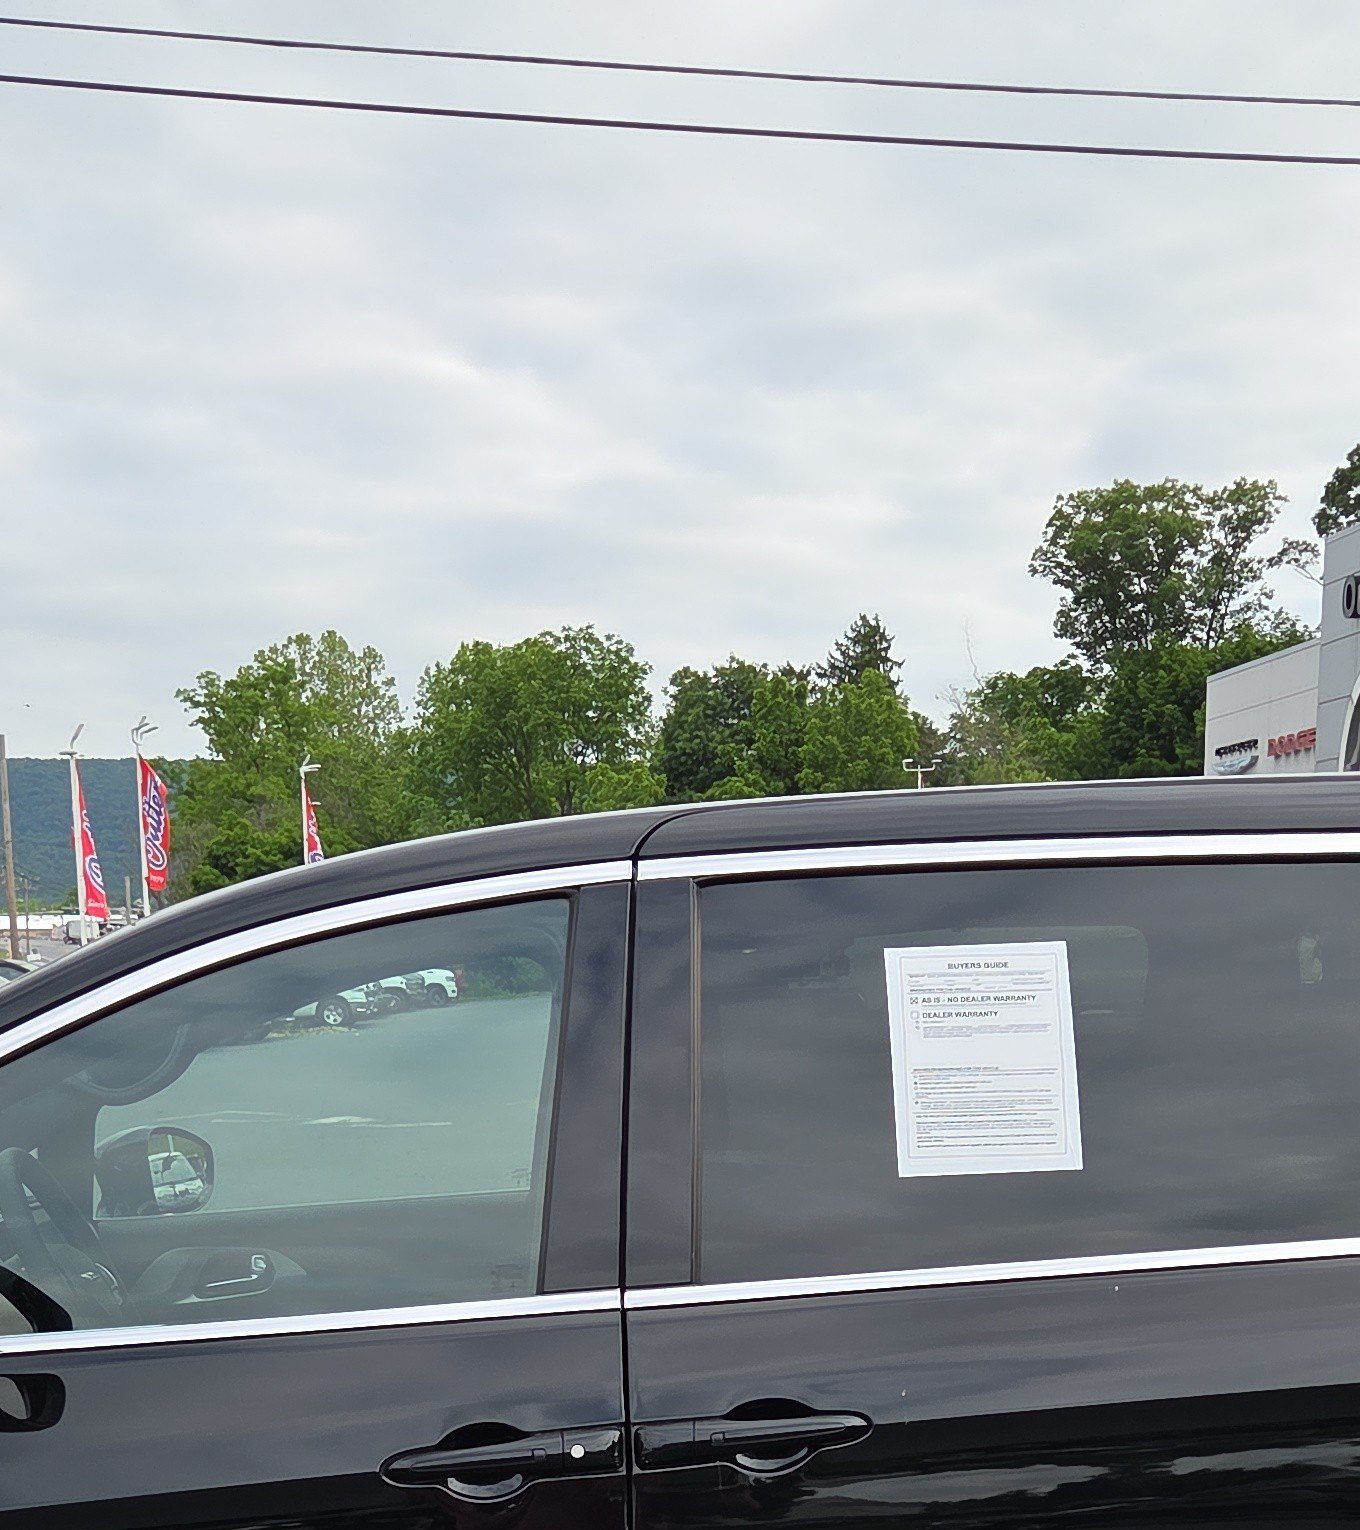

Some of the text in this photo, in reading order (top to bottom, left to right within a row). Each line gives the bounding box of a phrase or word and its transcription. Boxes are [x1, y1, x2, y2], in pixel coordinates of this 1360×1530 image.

[947, 961, 1009, 970] BUYERS GUIDE
[960, 995, 991, 1003] DEALER
[993, 994, 1037, 1002] WARRANTY
[922, 1010, 999, 1019] DEALER WARRANTY
